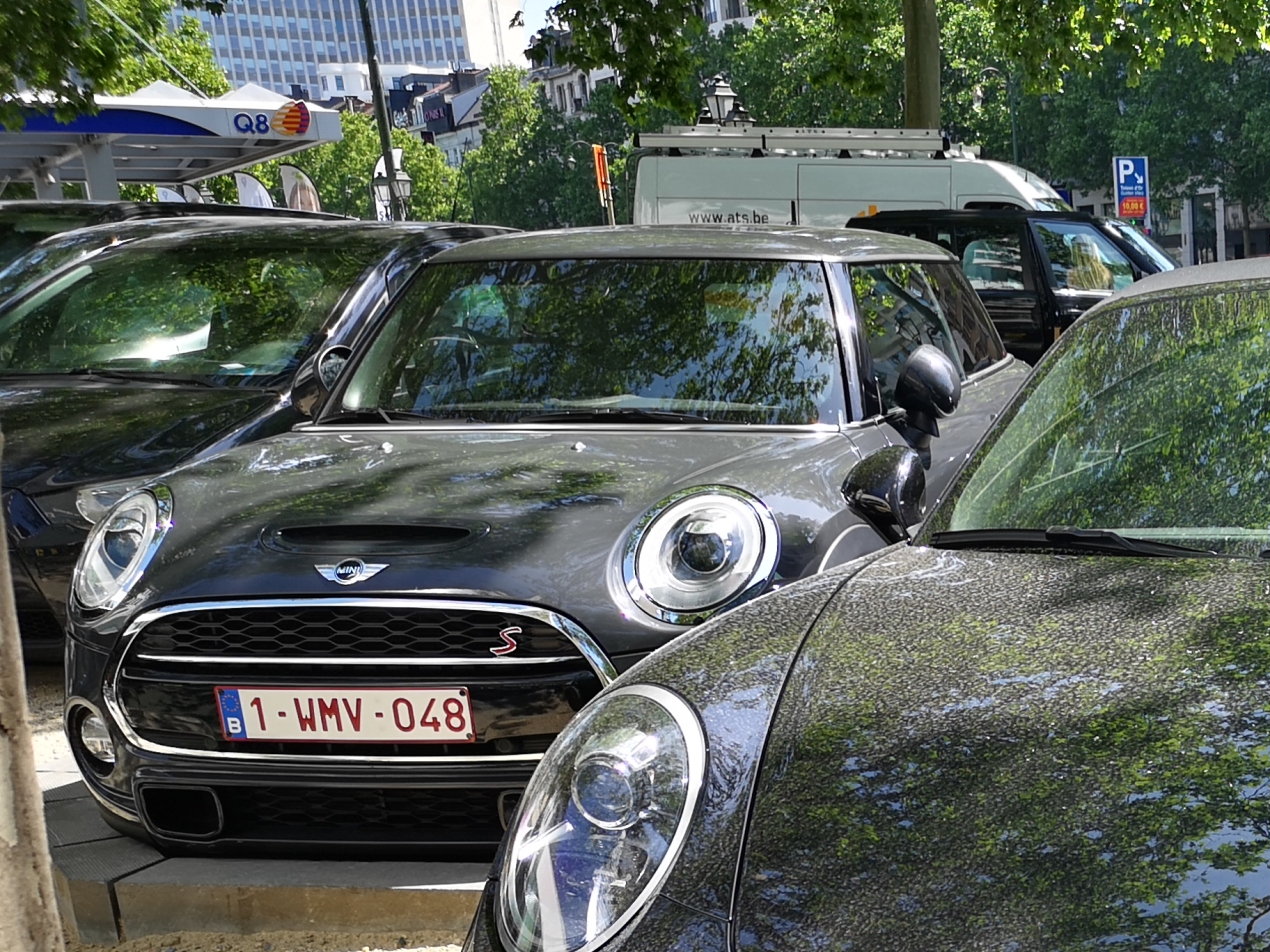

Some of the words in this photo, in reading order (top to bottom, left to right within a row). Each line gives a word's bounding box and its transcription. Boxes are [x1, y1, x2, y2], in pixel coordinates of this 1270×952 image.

[234, 112, 270, 134] Q8
[1119, 160, 1134, 184] P
[689, 210, 769, 224] www.ats.be
[490, 626, 522, 656] S
[226, 717, 242, 733] B
